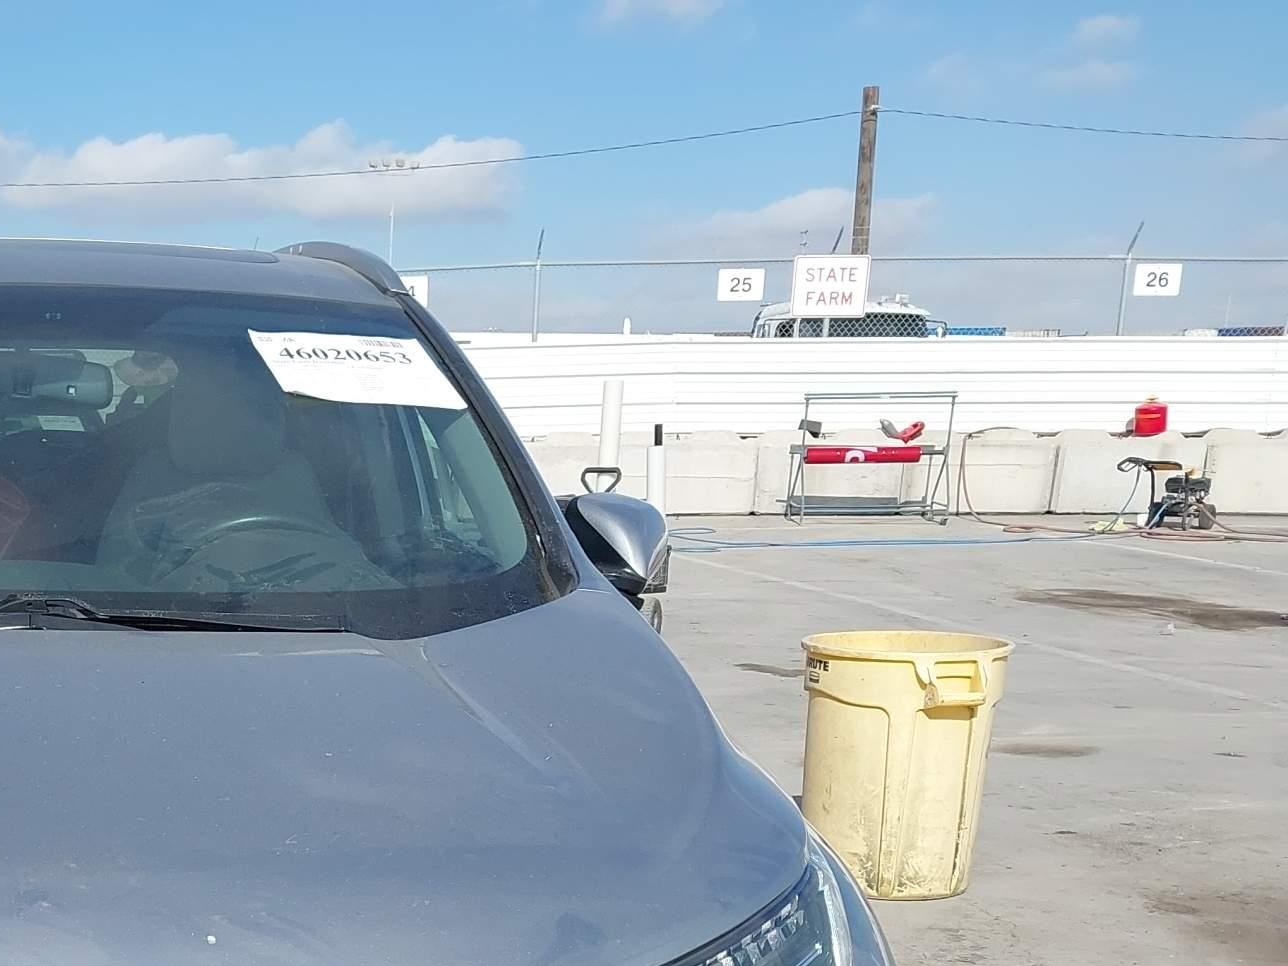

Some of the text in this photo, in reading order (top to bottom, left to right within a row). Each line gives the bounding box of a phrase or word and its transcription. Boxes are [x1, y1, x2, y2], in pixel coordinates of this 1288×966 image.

[805, 267, 859, 283] STATE
[1146, 271, 1169, 288] 26
[729, 277, 753, 293] 25
[805, 291, 853, 306] FARM
[279, 346, 413, 365] 46020653
